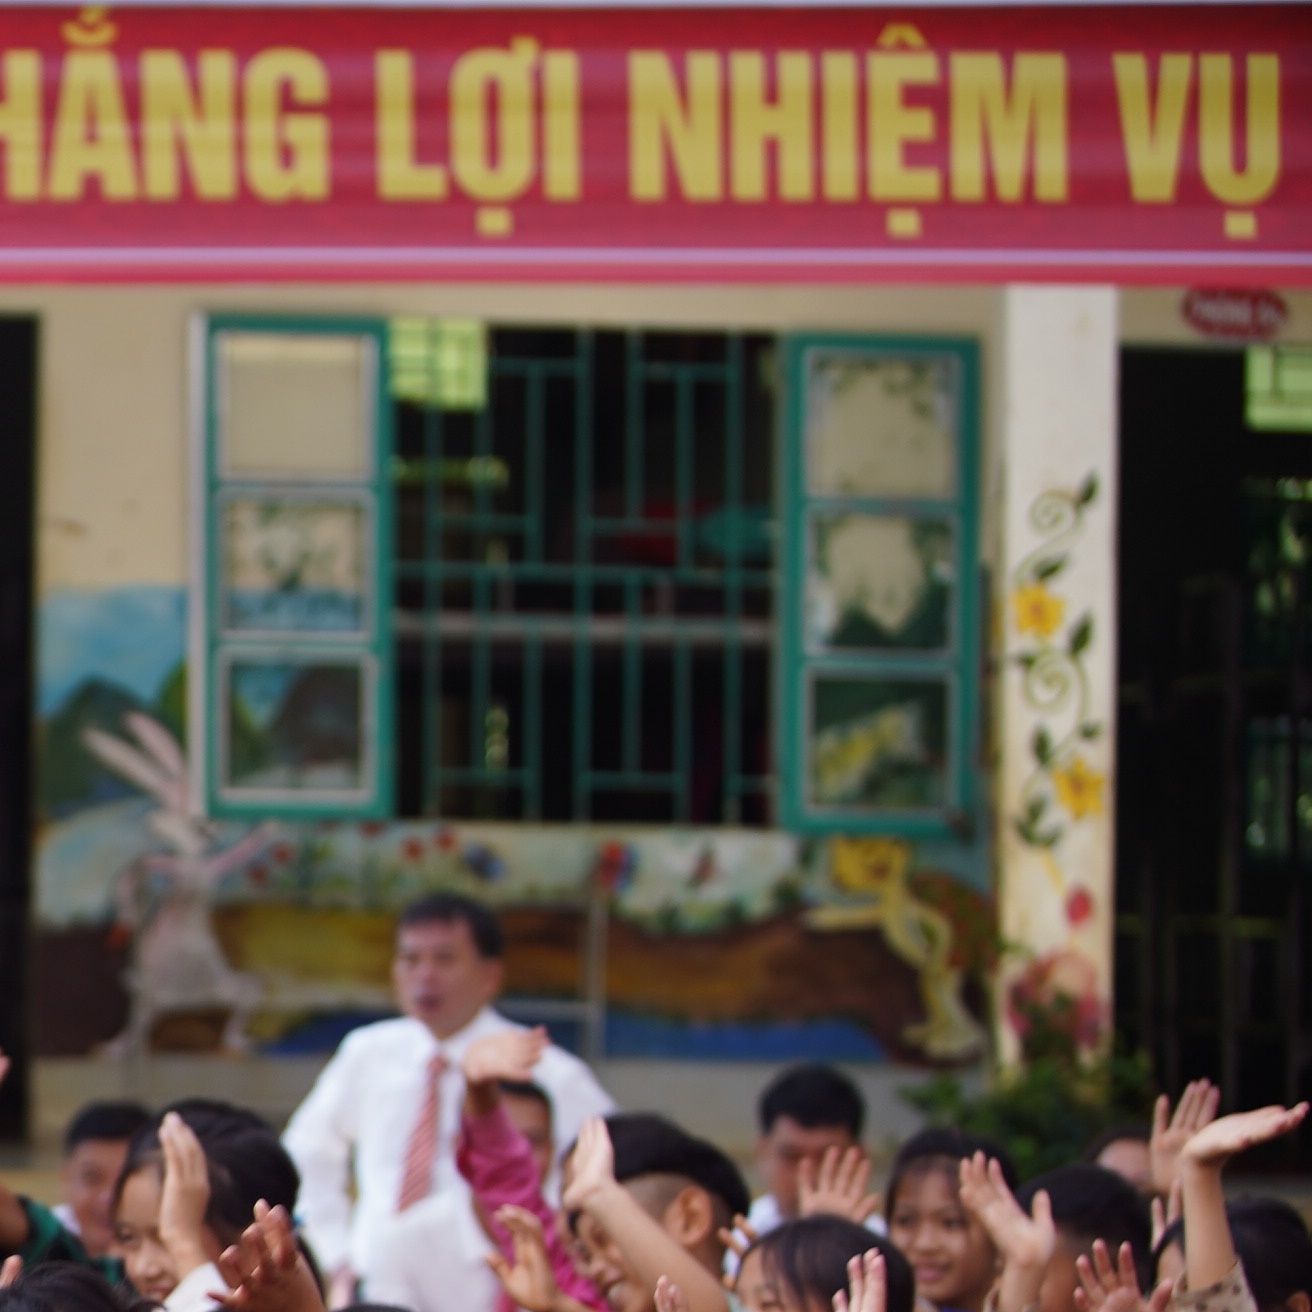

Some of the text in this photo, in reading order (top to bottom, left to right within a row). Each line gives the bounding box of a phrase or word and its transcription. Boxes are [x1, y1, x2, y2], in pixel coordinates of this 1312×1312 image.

[377, 39, 578, 233] LỢI
[630, 28, 1065, 234] NHIỆM
[1115, 55, 1278, 235] VỤ
